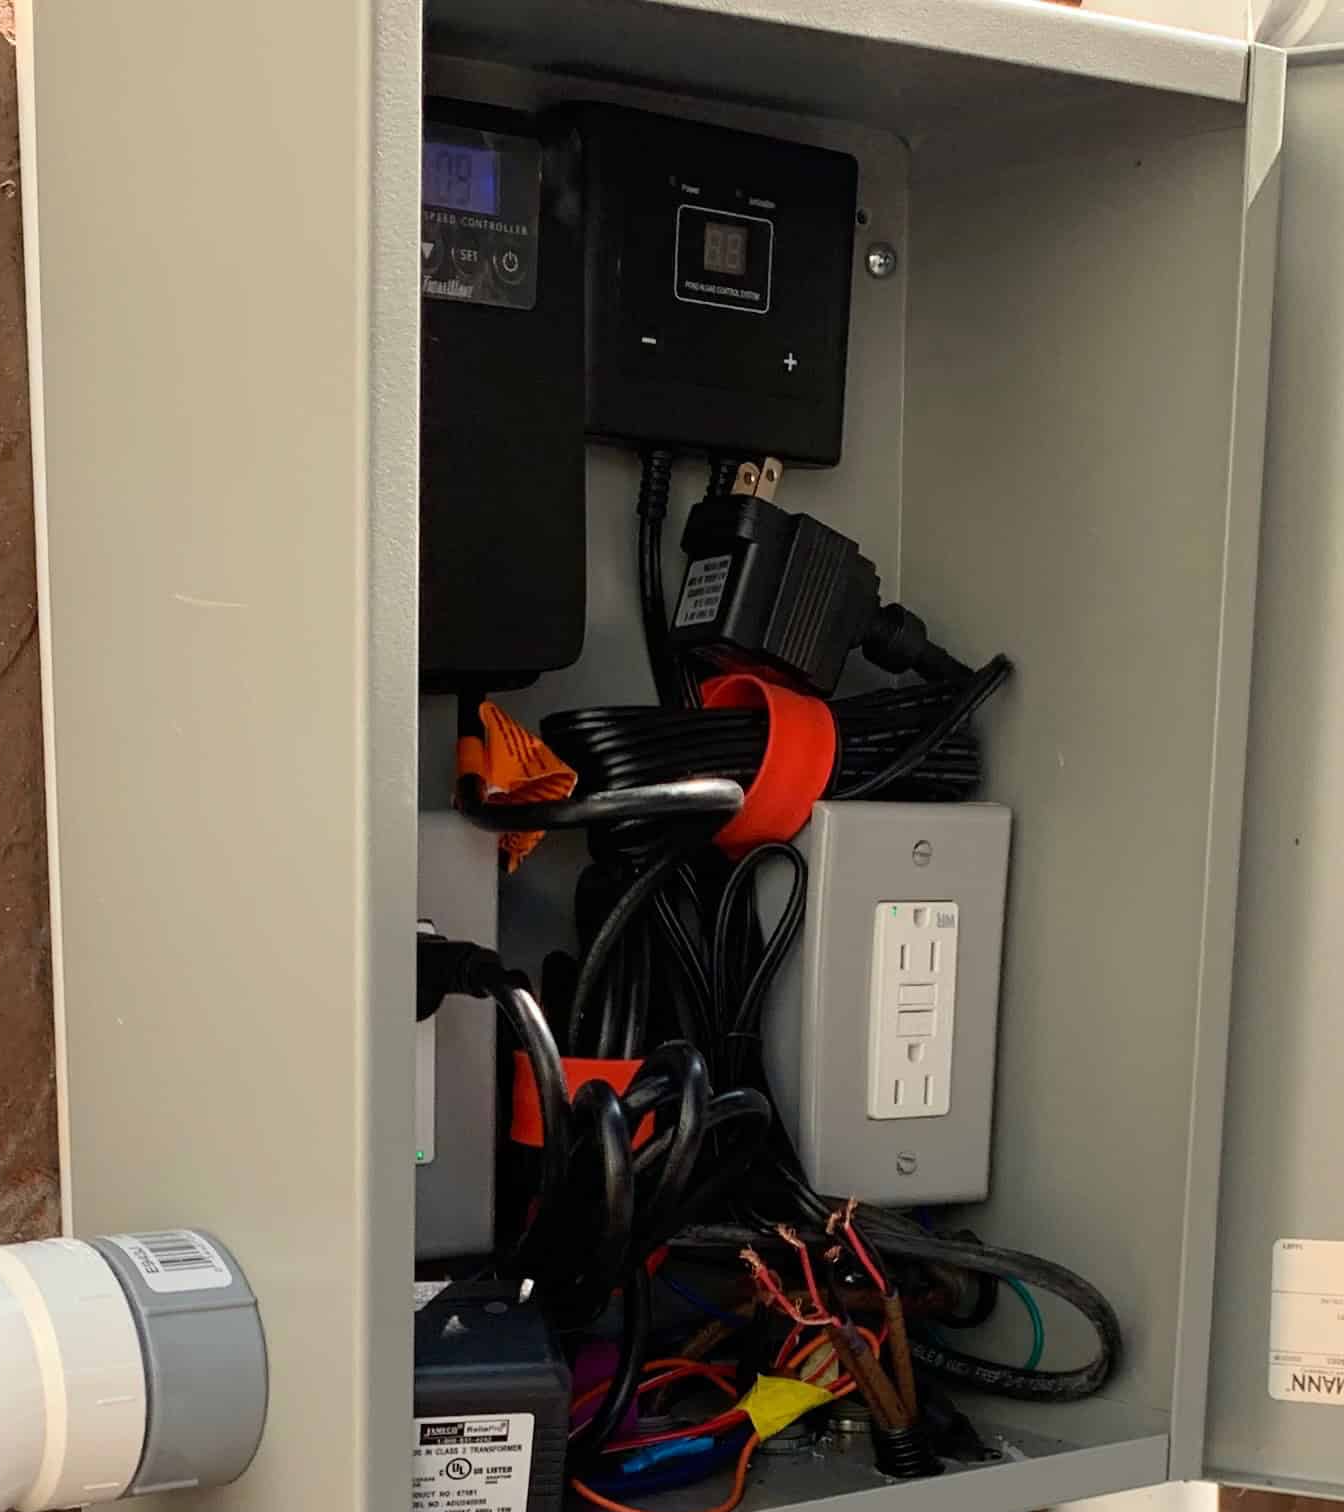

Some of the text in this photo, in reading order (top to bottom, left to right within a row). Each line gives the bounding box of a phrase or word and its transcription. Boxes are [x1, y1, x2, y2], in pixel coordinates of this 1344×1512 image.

[462, 216, 528, 236] CONTROLLER
[460, 248, 479, 262] SET
[435, 1447, 458, 1456] CLASS
[470, 1444, 522, 1454] TRANSFORMER
